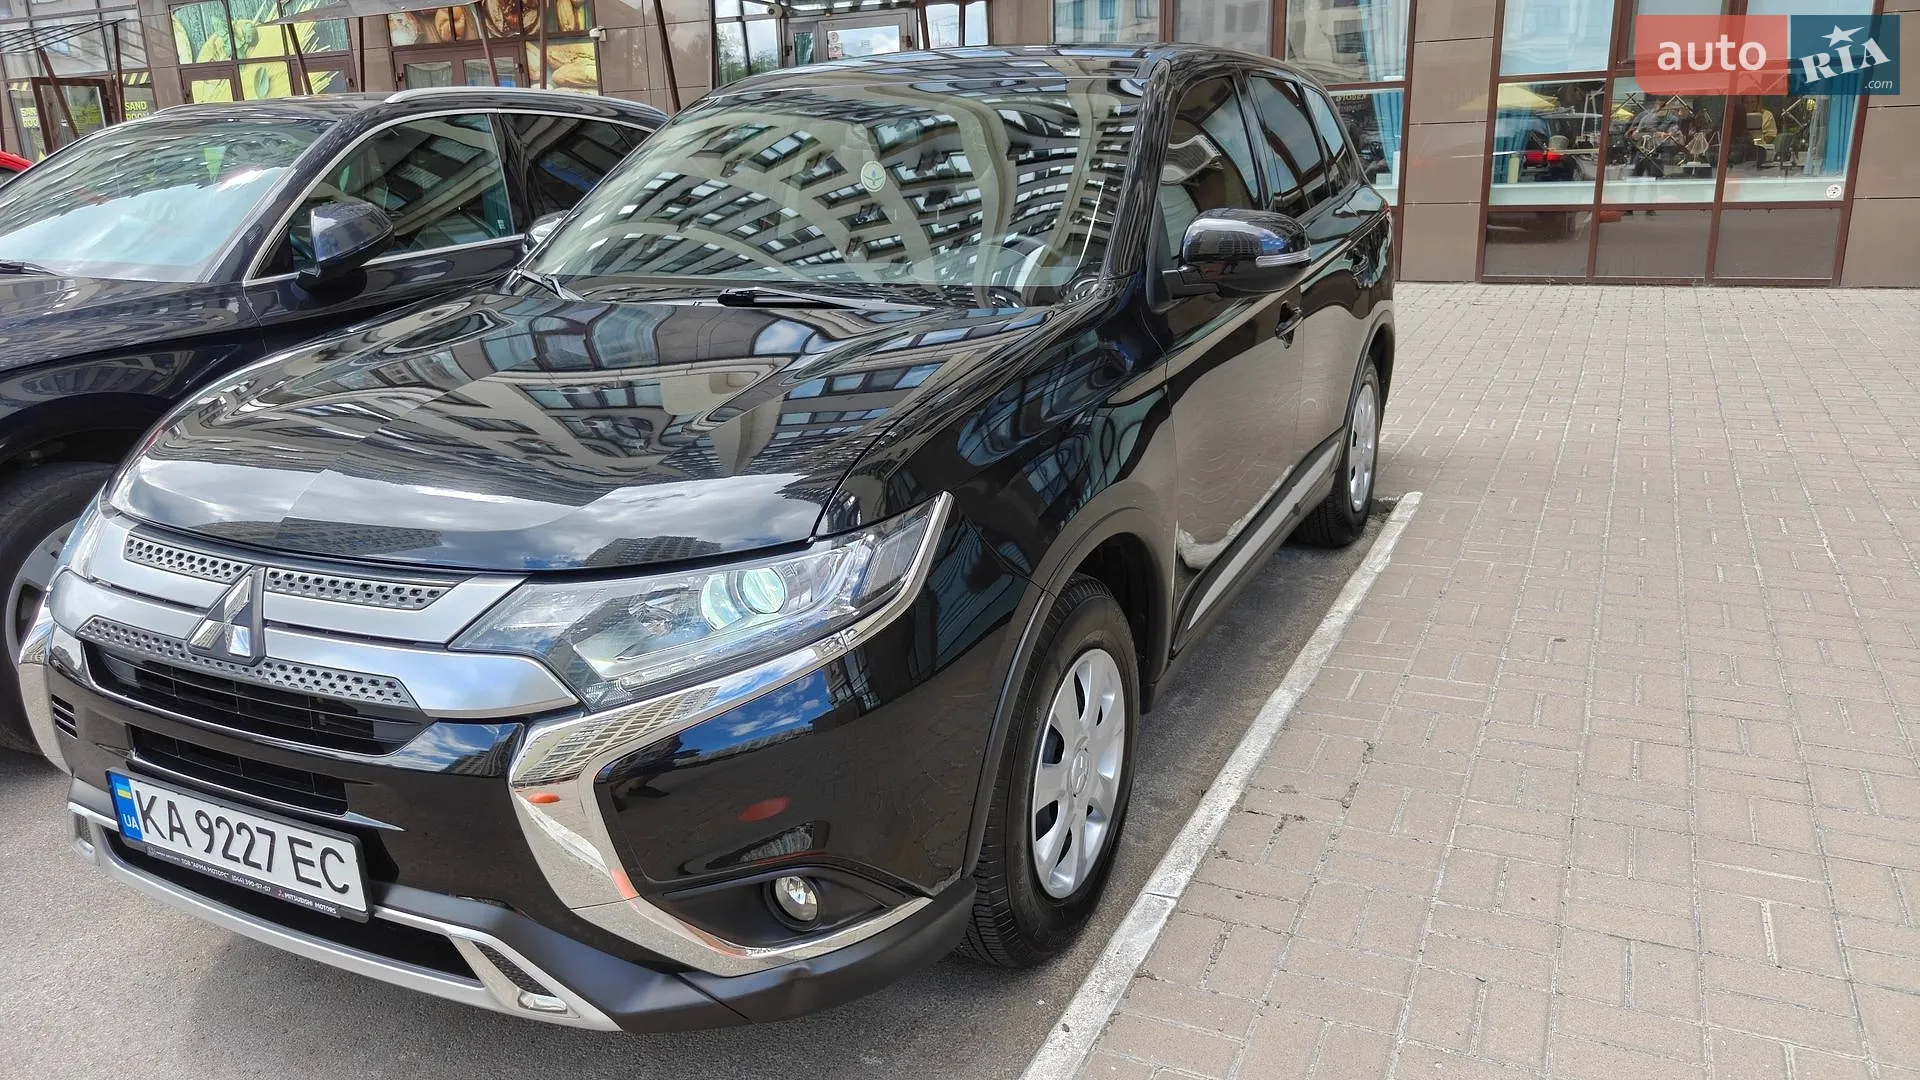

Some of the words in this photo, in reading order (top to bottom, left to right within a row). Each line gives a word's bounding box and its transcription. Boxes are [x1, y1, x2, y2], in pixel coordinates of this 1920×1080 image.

[125, 101, 147, 111] SAND
[123, 813, 139, 831] UA
[135, 790, 192, 848] KA
[195, 809, 276, 872] 9227
[287, 835, 350, 894] EC
[284, 892, 313, 906] MITSUBISHI
[314, 901, 337, 914] MOTORS
